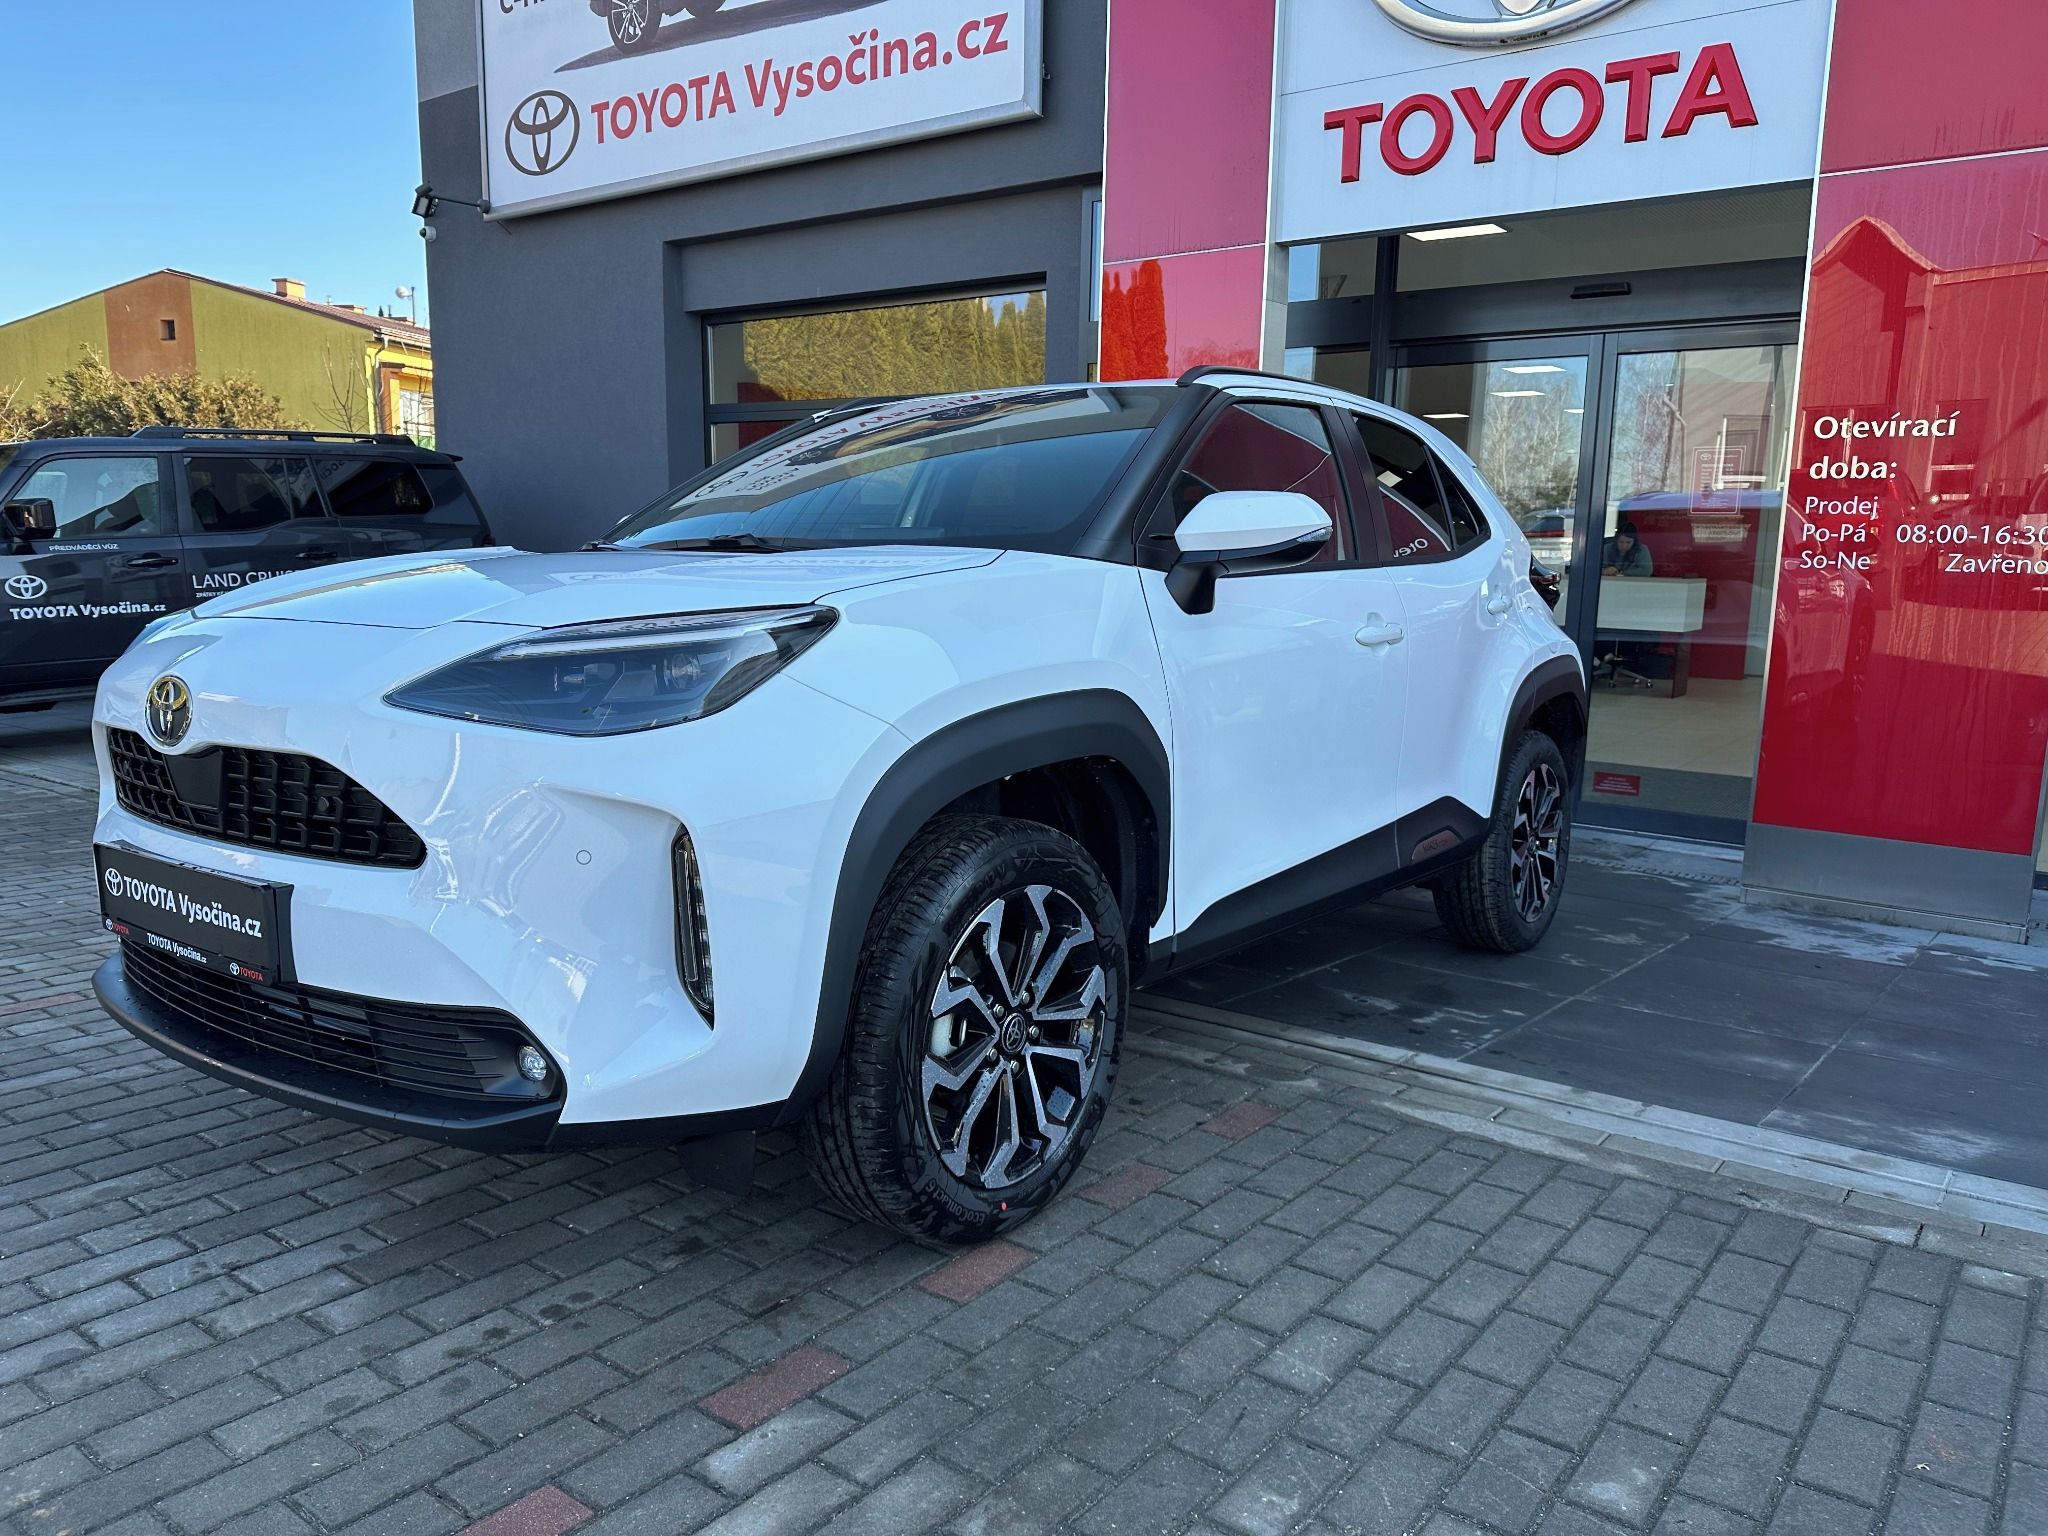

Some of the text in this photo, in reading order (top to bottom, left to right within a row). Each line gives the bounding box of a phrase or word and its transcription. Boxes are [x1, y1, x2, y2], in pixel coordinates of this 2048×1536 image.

[590, 12, 1009, 144] TOYOTA Vysočina.cz
[1323, 42, 1759, 184] TOYOTA
[1813, 410, 1961, 439] Otevírací
[1809, 455, 1898, 480] doba:
[1805, 496, 1879, 520] Prodej
[1801, 523, 2048, 545] Po-Pá 08:00-16:30
[1799, 550, 2048, 575] So-Ne Zavřeno
[192, 573, 241, 589] LAND
[9, 601, 167, 620] TOYOTA Vysočina.cz
[123, 875, 262, 938] TOYOTA Vysočina.cz
[147, 932, 207, 964] TOYOTA Vysočina.cz
[239, 966, 264, 982] TOYOTA
